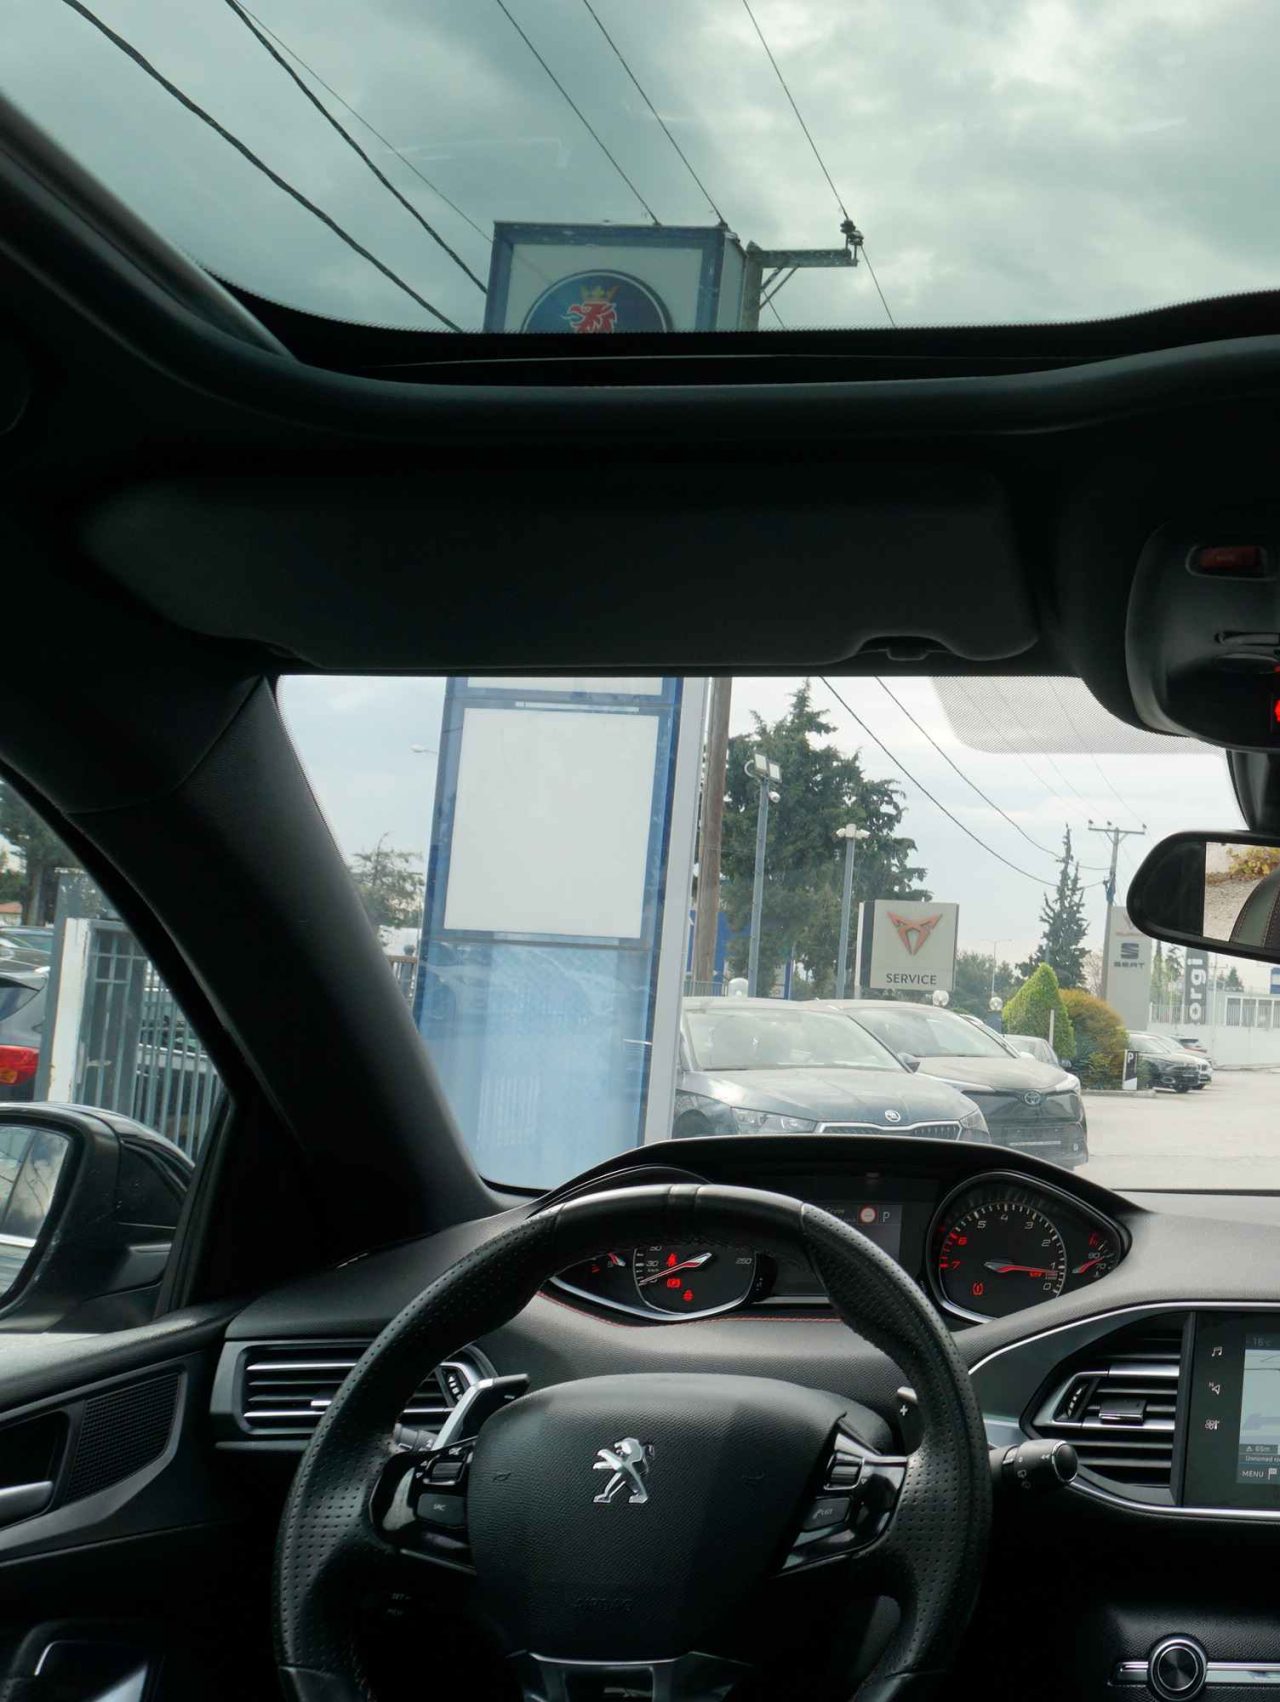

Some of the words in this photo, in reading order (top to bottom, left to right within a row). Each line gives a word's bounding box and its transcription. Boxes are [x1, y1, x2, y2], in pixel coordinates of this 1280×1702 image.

[1113, 961, 1145, 969] SEAT
[886, 973, 937, 985] SERVICE
[1127, 1052, 1134, 1064] P
[882, 1211, 890, 1222] P
[977, 1220, 986, 1229] 5
[1024, 1221, 1034, 1230] 3
[958, 1236, 967, 1245] 6
[1041, 1239, 1051, 1247] 2
[1043, 1282, 1051, 1291] 0
[1242, 1470, 1264, 1478] MENU
